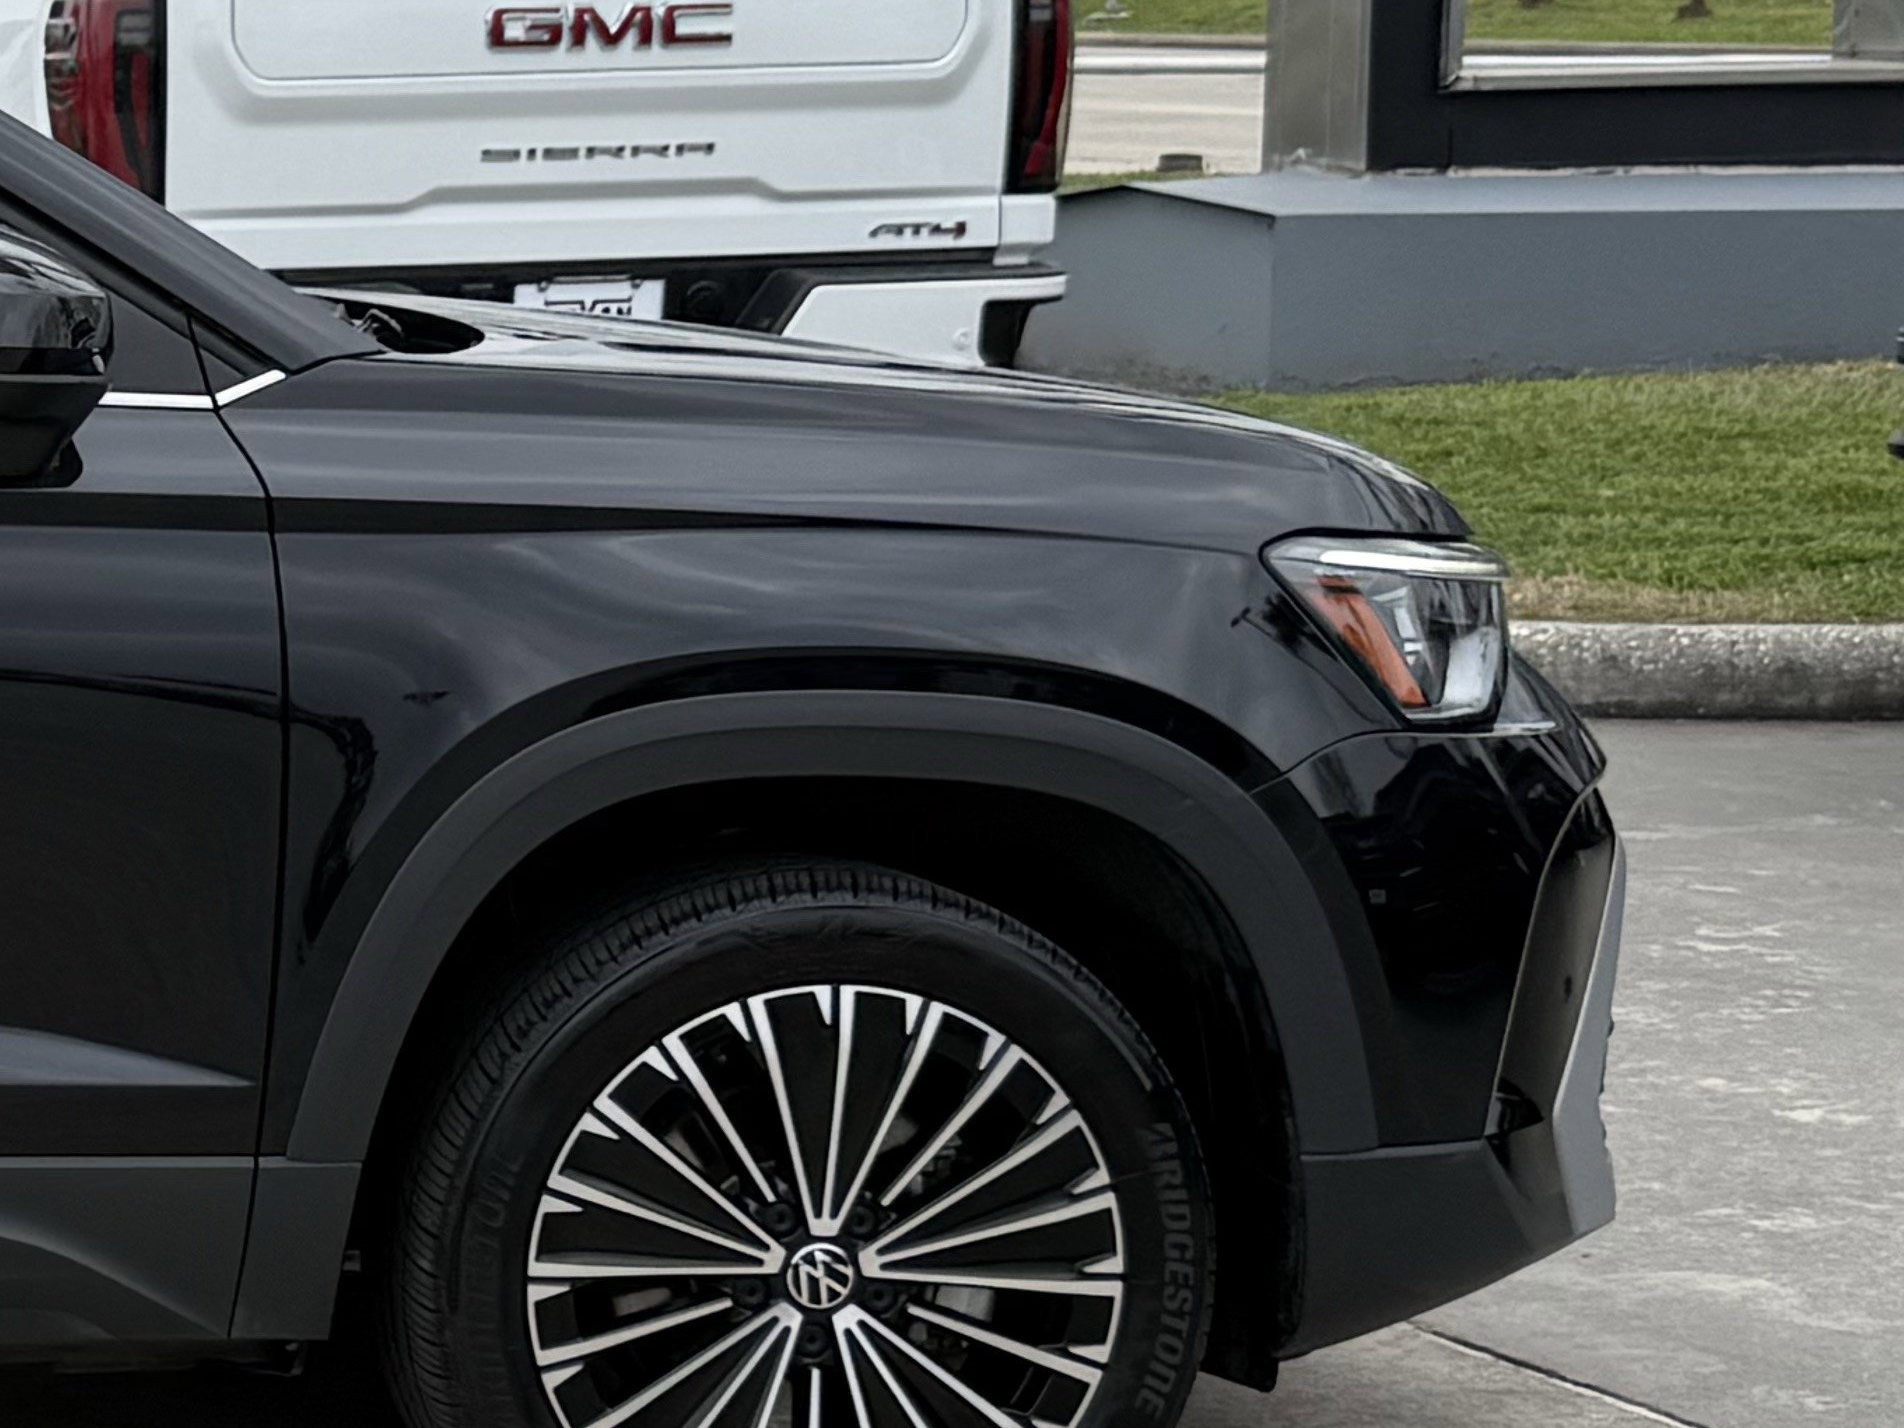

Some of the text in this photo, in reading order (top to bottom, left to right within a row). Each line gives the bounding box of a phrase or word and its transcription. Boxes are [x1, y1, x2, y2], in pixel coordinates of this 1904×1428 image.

[485, 1, 734, 53] GMC
[480, 141, 716, 163] SIERRA
[868, 220, 967, 240] AT4
[1134, 1122, 1194, 1421] BRIDGESTONE
